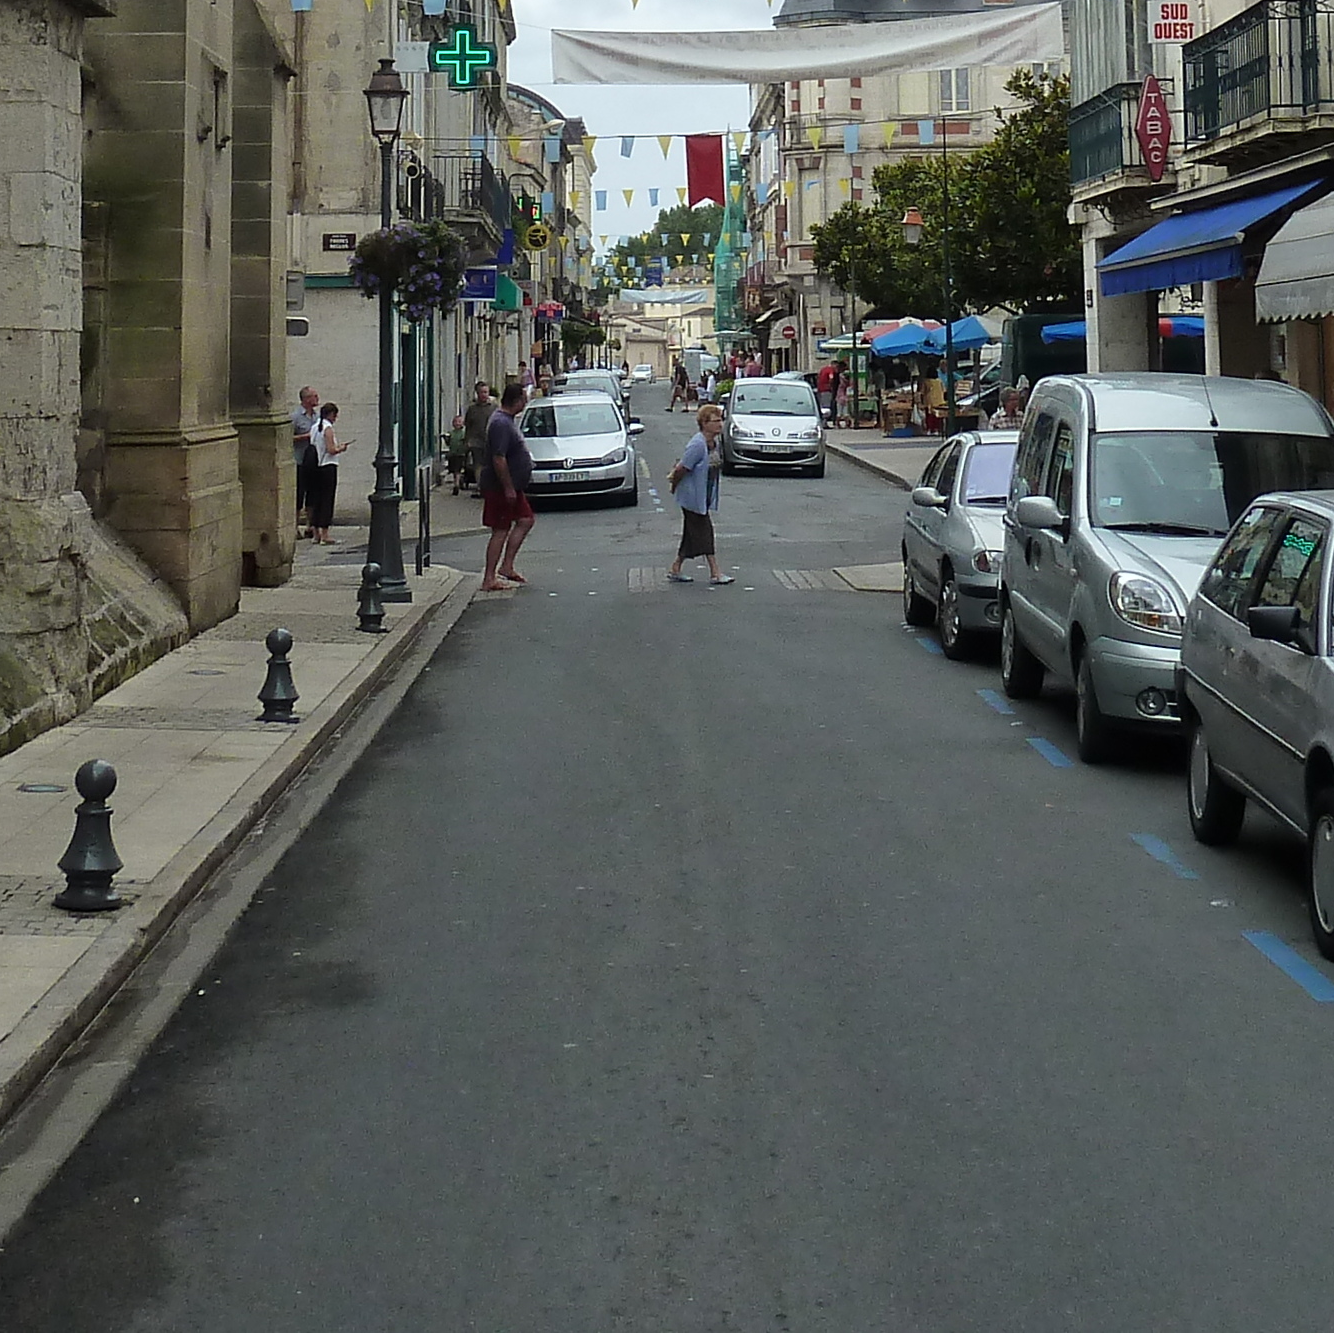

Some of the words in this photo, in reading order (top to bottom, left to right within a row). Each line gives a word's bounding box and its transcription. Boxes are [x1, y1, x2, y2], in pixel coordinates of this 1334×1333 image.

[1160, 3, 1188, 20] SUD
[1154, 22, 1195, 40] OUEST
[1146, 92, 1163, 163] TABAC
